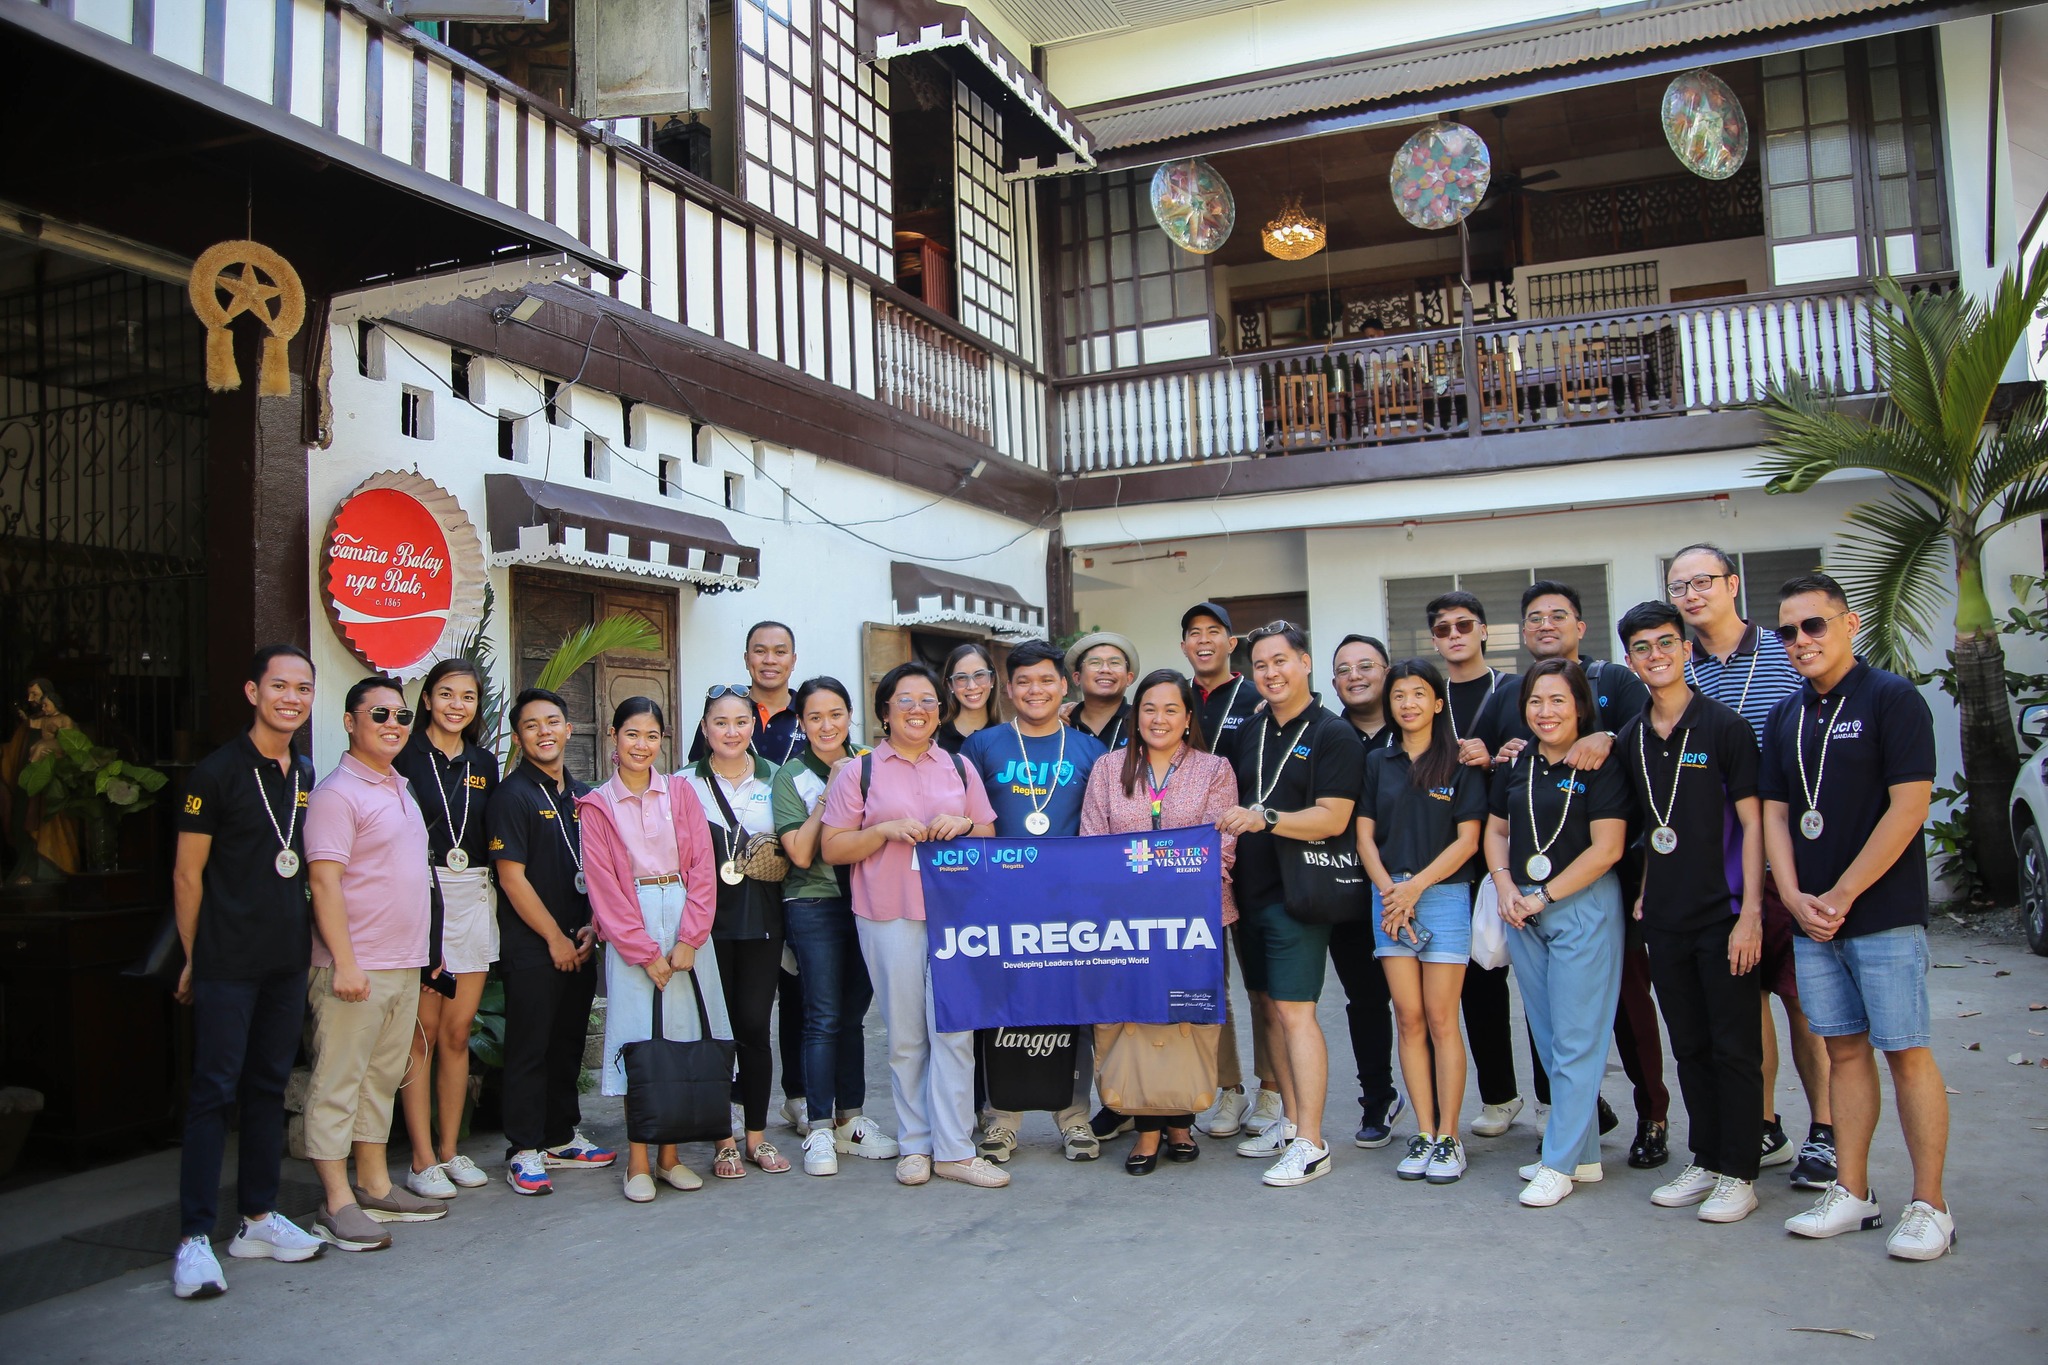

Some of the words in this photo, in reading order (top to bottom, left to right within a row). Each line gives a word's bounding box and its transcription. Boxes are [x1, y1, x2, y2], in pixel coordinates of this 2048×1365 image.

[392, 542, 444, 579] Balay
[345, 573, 377, 597] nga
[381, 567, 426, 600] Bato,
[384, 598, 401, 607] 1865
[1832, 722, 1851, 733] JCI
[1293, 745, 1311, 757] JCI
[1682, 752, 1698, 764] JCI
[997, 760, 1049, 785] JCI
[1012, 785, 1047, 796] Regatta
[1557, 779, 1579, 790] JCI
[186, 794, 202, 810] 50
[750, 793, 767, 801] JCI
[932, 850, 964, 866] JCI
[991, 848, 1022, 863] JCI
[1155, 847, 1209, 858] WESTERN
[1155, 857, 1202, 867] VISAYAS
[935, 925, 1001, 960] JCI
[1010, 918, 1217, 955] REGATTA
[1003, 961, 1043, 969] Developing
[1044, 959, 1073, 967] Leaders
[1092, 957, 1127, 965] Changing
[994, 1026, 1071, 1057] langga
